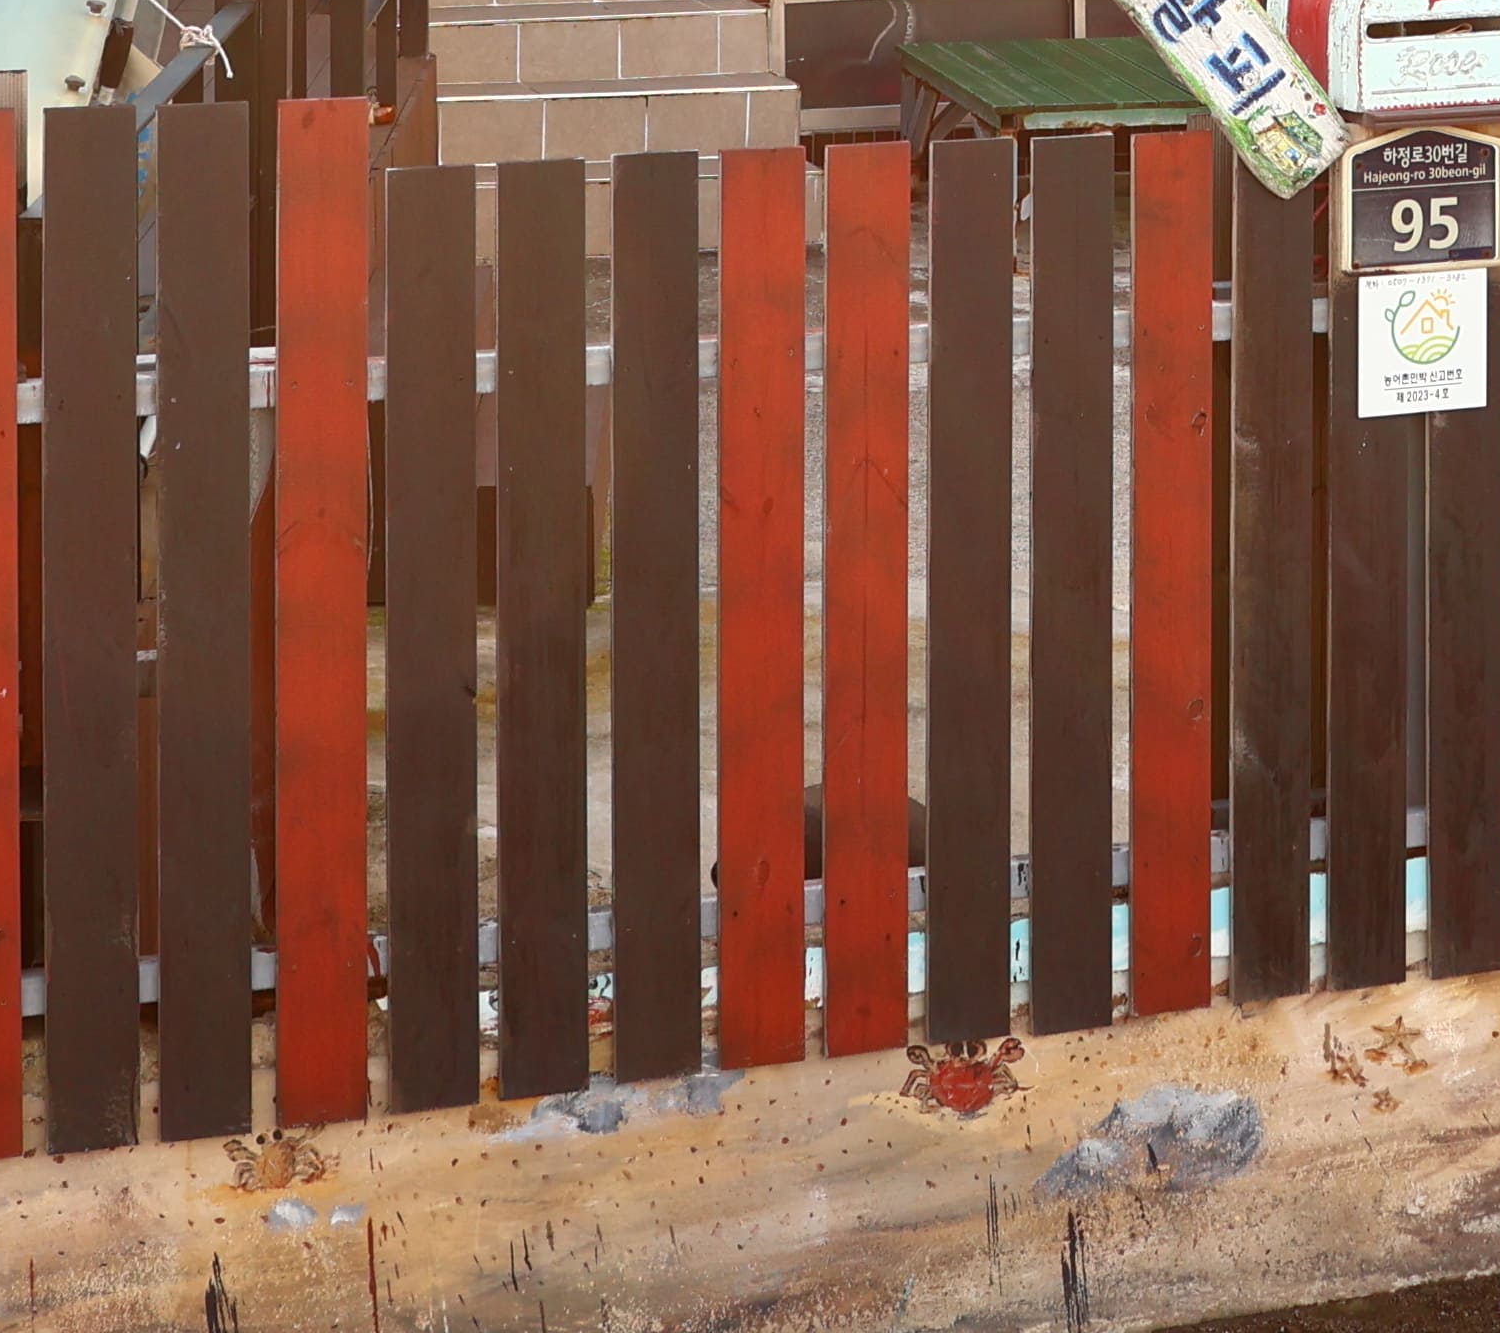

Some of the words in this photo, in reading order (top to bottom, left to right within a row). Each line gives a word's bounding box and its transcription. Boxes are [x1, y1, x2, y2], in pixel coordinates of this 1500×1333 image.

[1383, 143, 1468, 168] 하정로30번길
[1363, 170, 1426, 185] Hajeong-ro
[1428, 163, 1486, 179] 30beon-gil
[1391, 196, 1459, 252] 95
[1429, 368, 1463, 383] 신고번호
